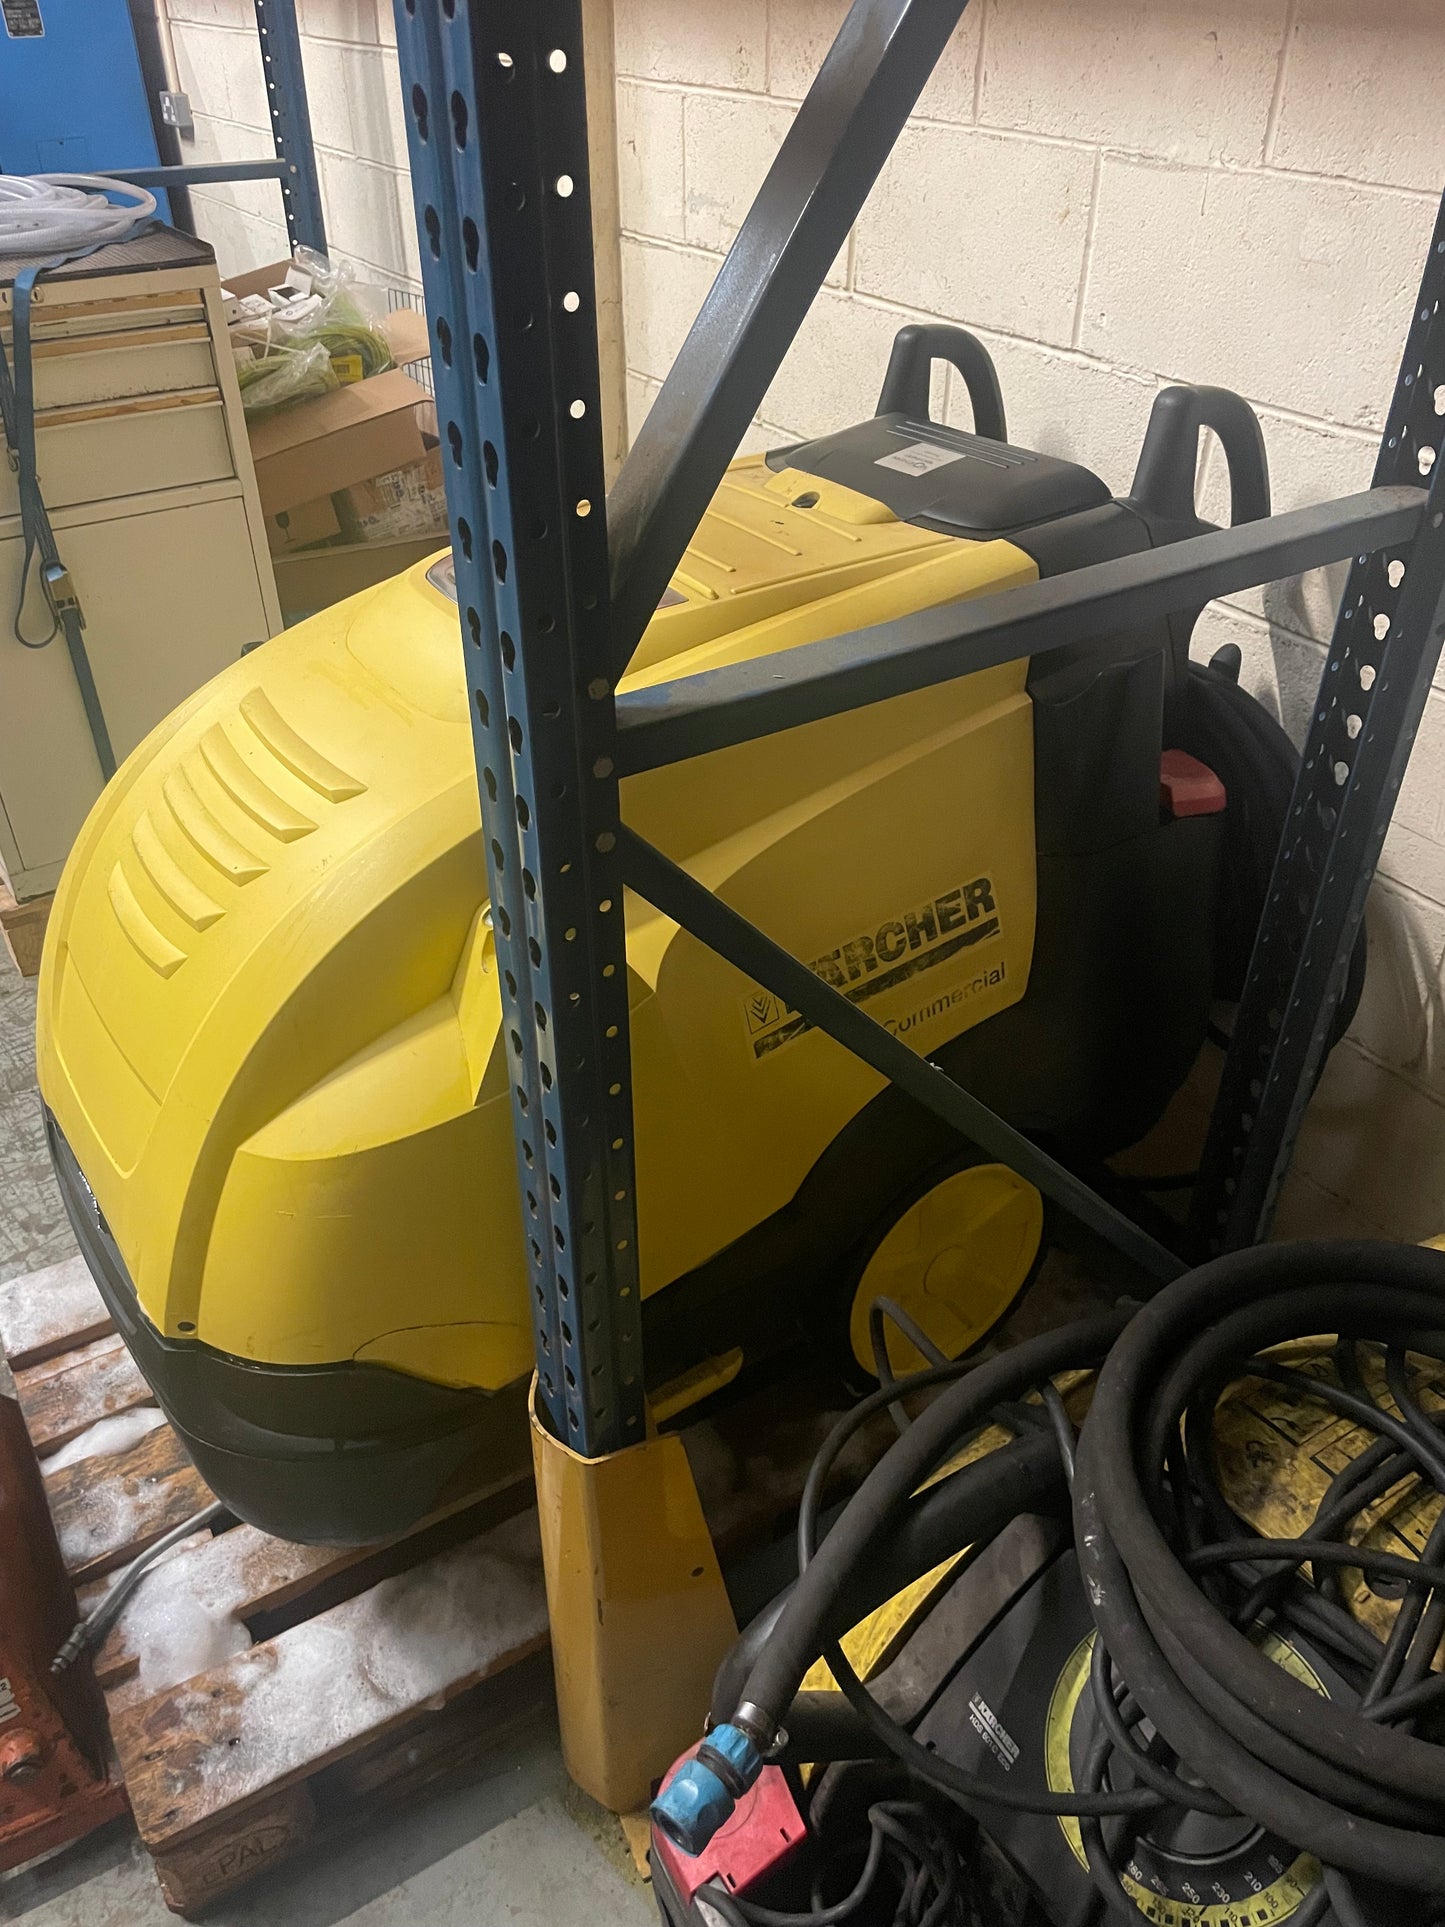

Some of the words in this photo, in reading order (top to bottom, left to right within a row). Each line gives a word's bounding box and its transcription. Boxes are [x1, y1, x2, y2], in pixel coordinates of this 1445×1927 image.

[786, 877, 996, 1014] ÄRCHER
[1182, 1882, 1200, 1904] 250
[1212, 1882, 1231, 1903] 230
[1243, 1871, 1262, 1892] 210
[1224, 1905, 1238, 1923] 110
[1264, 1891, 1279, 1909] 100
